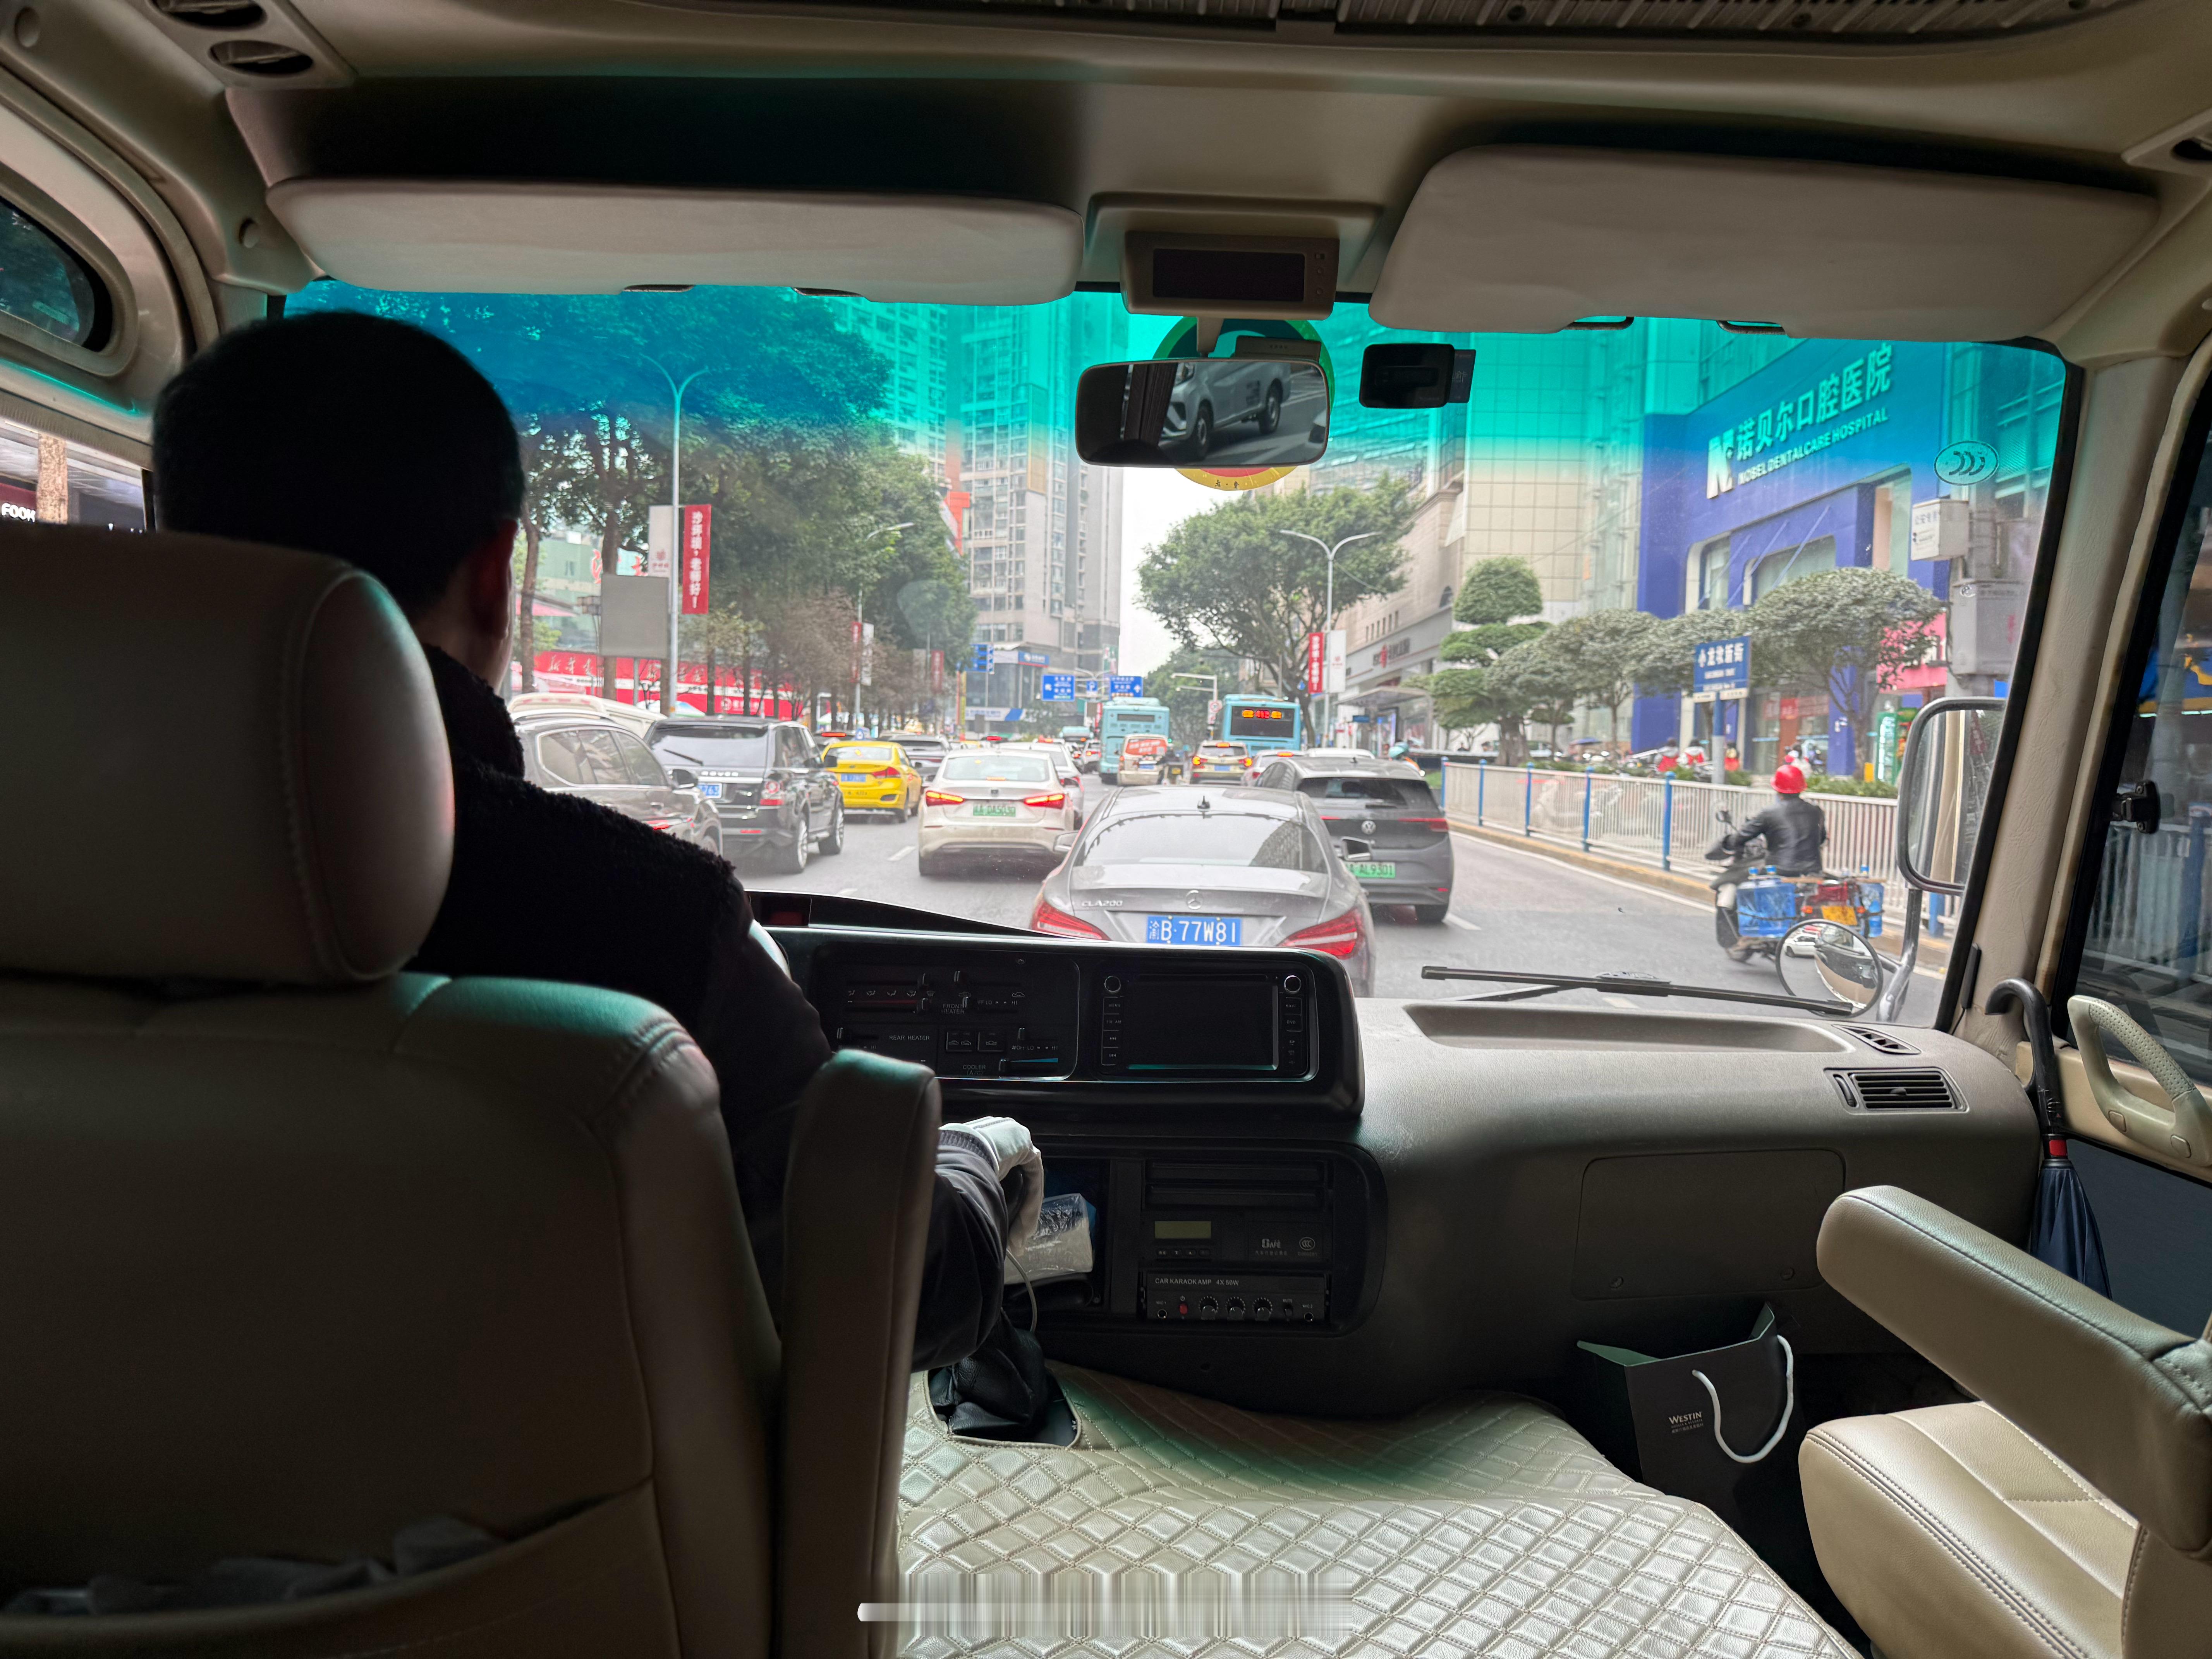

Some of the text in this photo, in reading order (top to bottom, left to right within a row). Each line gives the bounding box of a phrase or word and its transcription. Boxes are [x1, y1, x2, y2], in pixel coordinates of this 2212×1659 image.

[1736, 343, 1892, 461] 诺贝尔口腔医院
[1738, 407, 1889, 484] NOBEL DENTAL CARE HOSPITAL
[2, 503, 36, 522] FOOK
[1668, 1411, 1702, 1425] WESTIN
